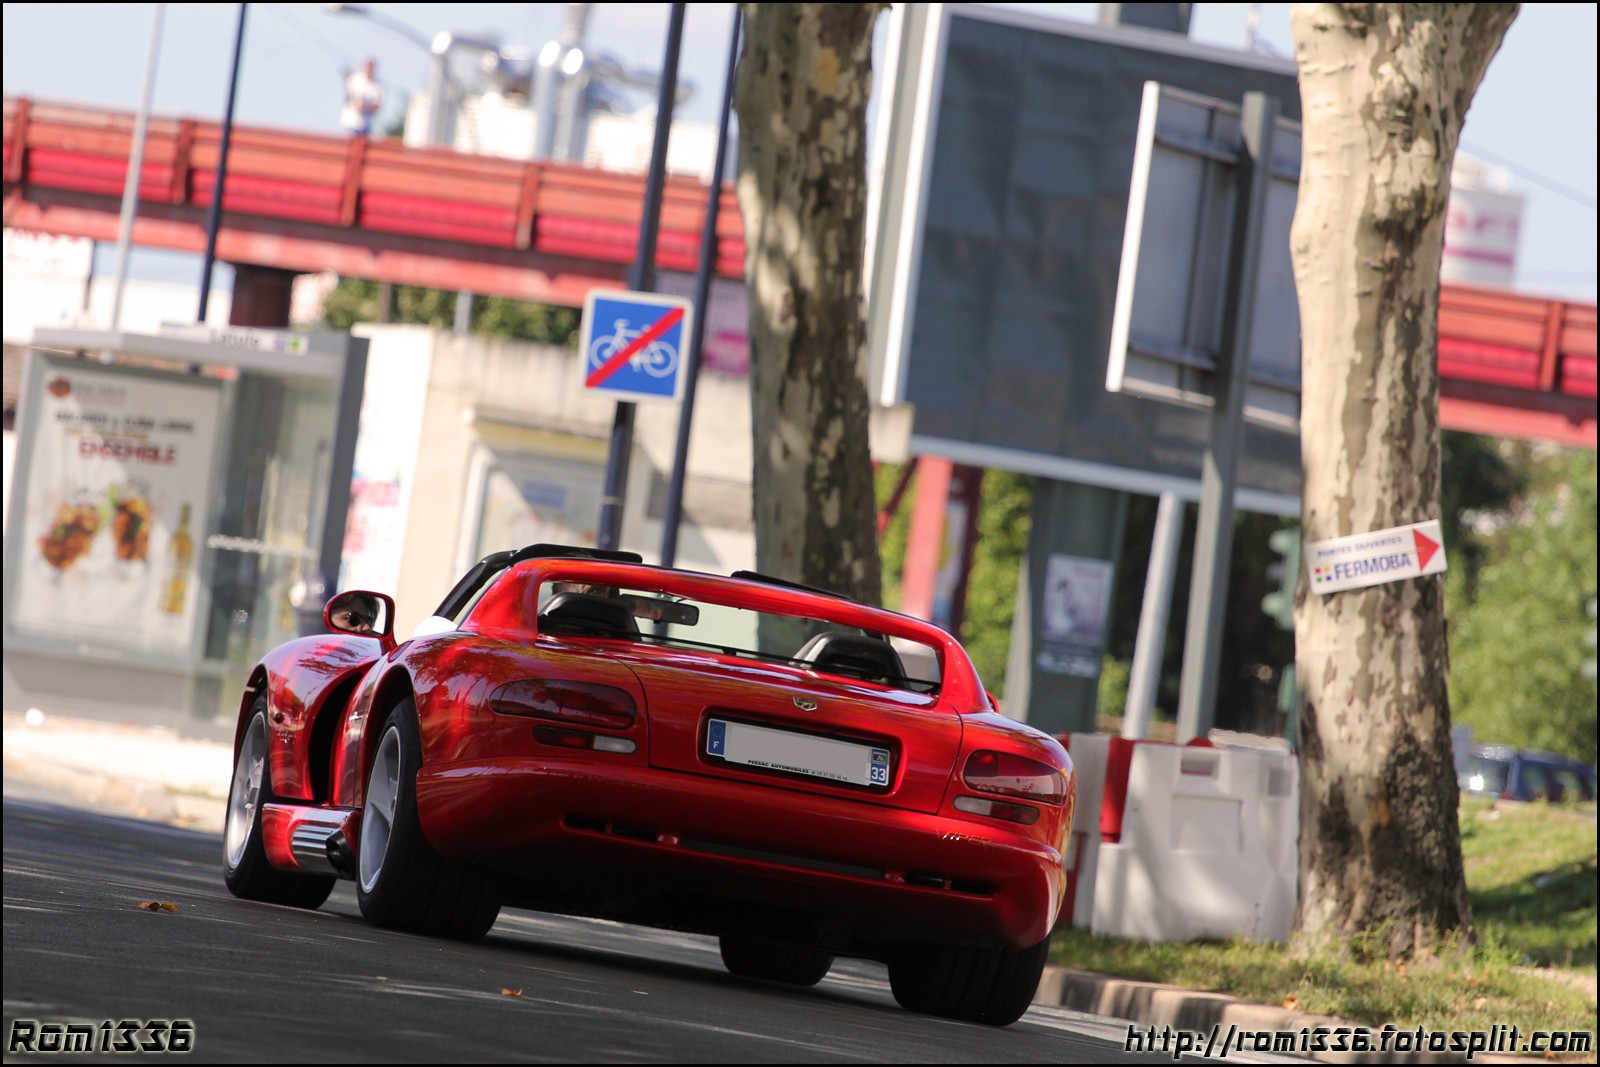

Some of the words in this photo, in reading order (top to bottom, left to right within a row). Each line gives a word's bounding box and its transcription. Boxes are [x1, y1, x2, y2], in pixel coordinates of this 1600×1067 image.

[1355, 536, 1403, 552] OUVERTES
[1334, 553, 1411, 581] FERMOBA
[713, 741, 719, 749] F
[771, 763, 809, 774] AUTOMOBILES
[871, 767, 886, 781] 33
